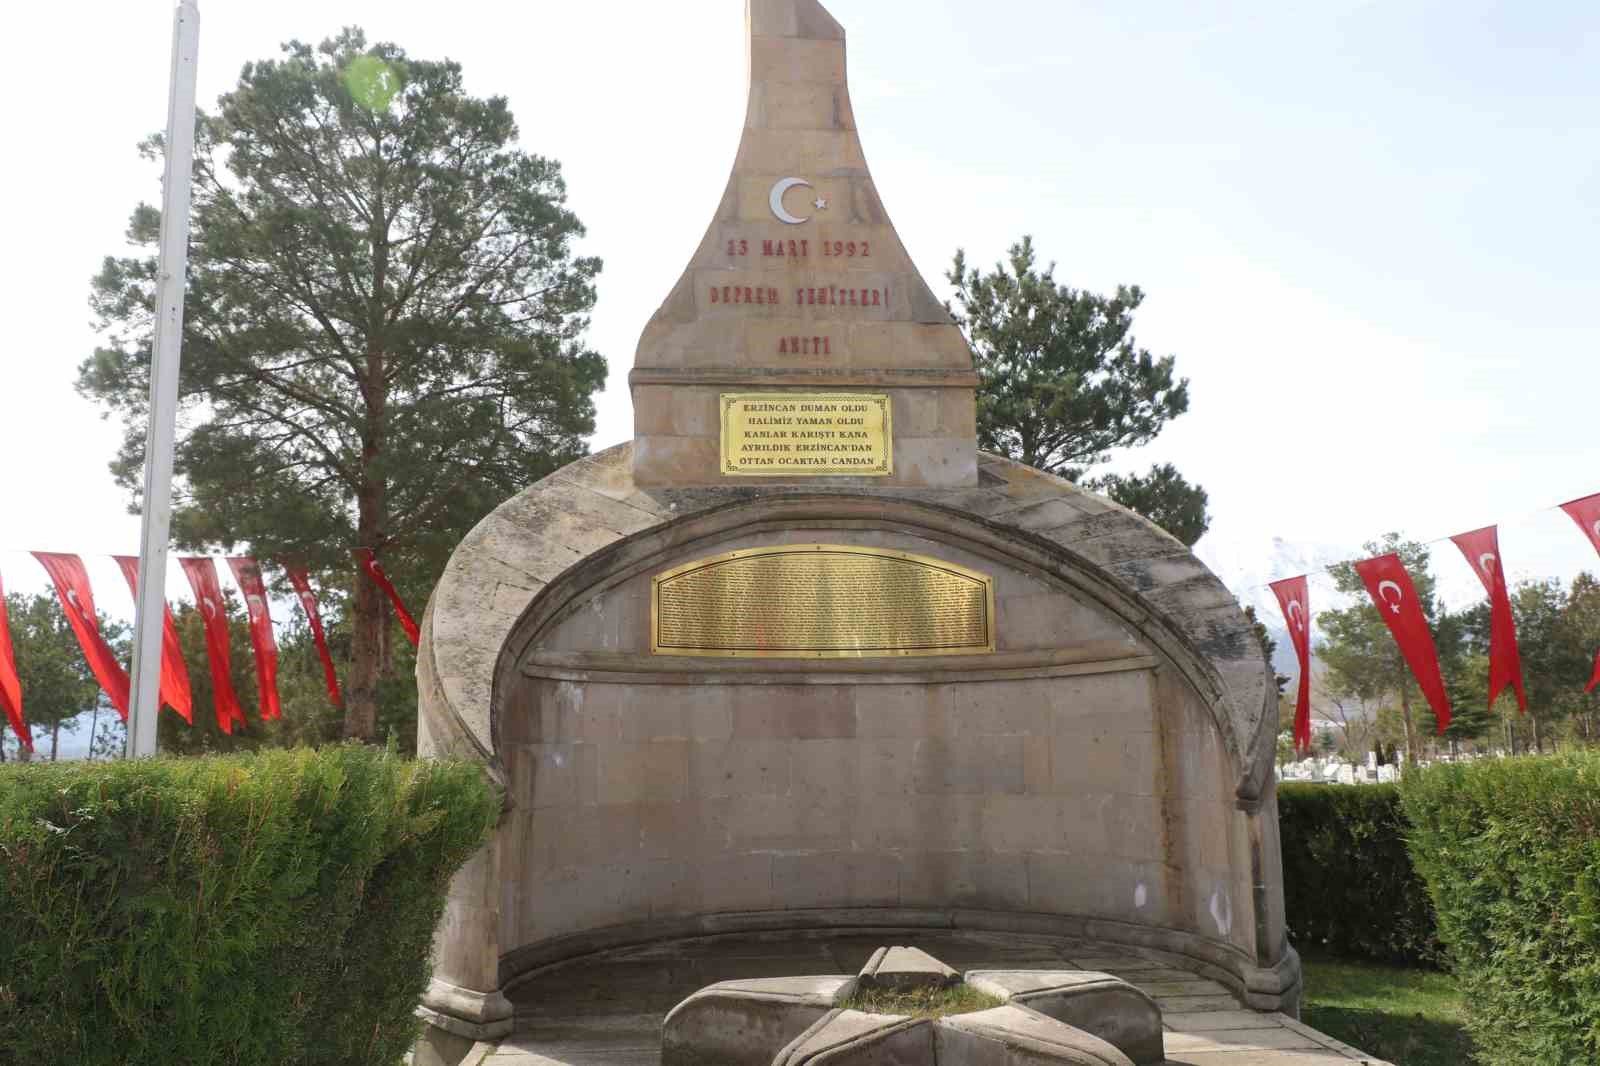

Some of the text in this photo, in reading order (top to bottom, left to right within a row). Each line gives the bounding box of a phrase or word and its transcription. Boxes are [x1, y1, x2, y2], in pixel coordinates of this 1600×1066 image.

[762, 240, 808, 256] MART
[824, 241, 870, 256] 1992
[743, 403, 795, 412] ERZİNCAN
[748, 416, 792, 425] HALİMİZ
[791, 431, 835, 439] KARIŞTI
[796, 443, 872, 451] ERZİNCAN'DAN
